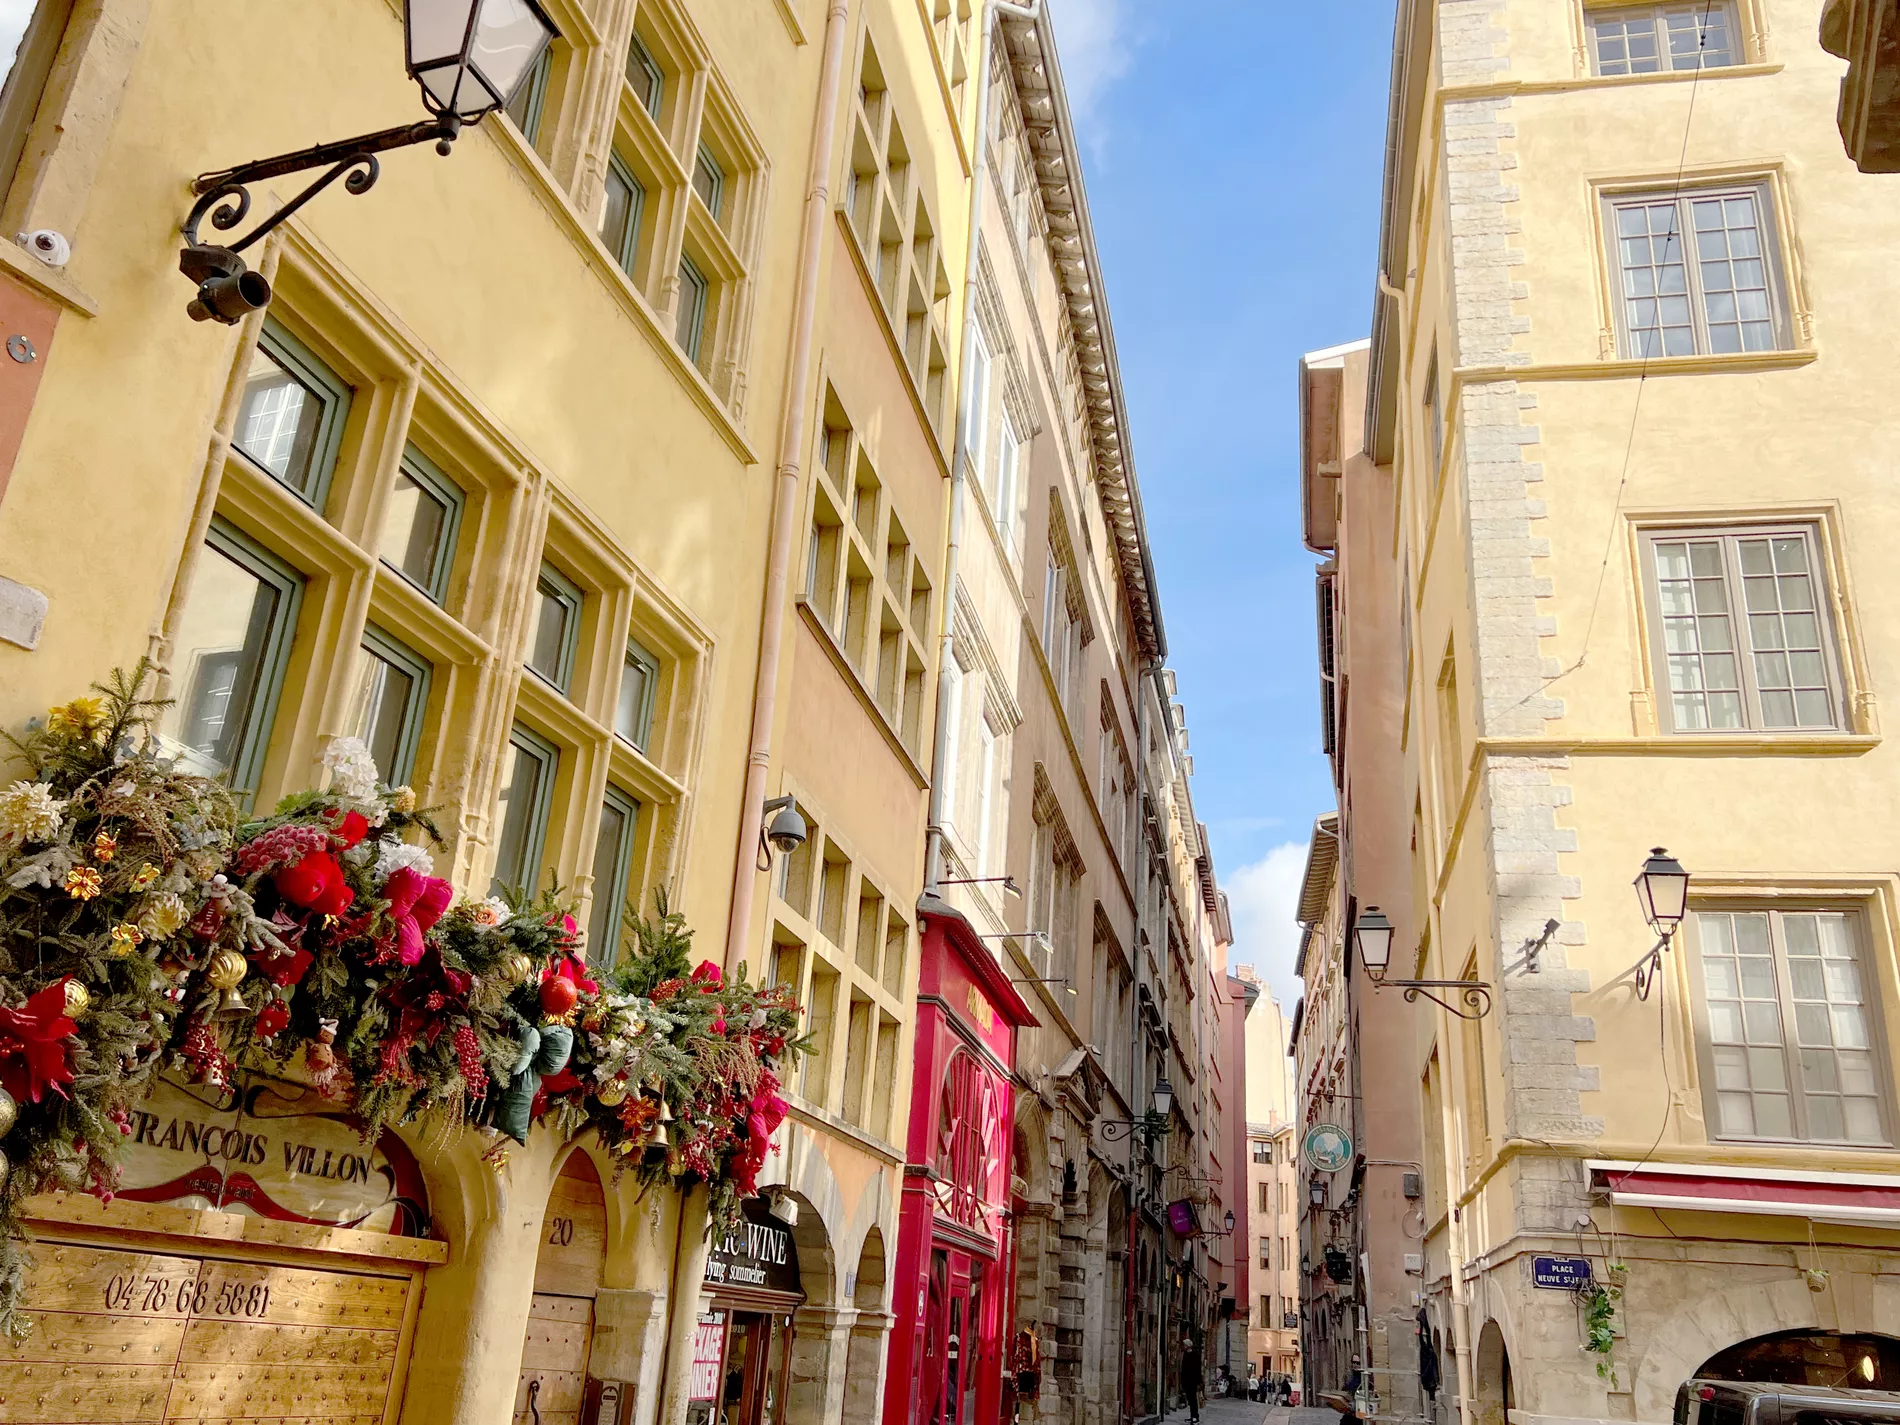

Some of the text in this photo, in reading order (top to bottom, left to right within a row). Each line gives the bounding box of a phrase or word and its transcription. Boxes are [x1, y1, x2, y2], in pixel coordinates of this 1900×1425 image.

[284, 1141, 371, 1185] VILLON
[549, 1217, 574, 1247] 20
[747, 1222, 788, 1265] WINE
[729, 1262, 766, 1285] sommelier
[1538, 1274, 1560, 1283] NEUVE
[1552, 1264, 1574, 1274] PLACE
[142, 1275, 169, 1312] 78
